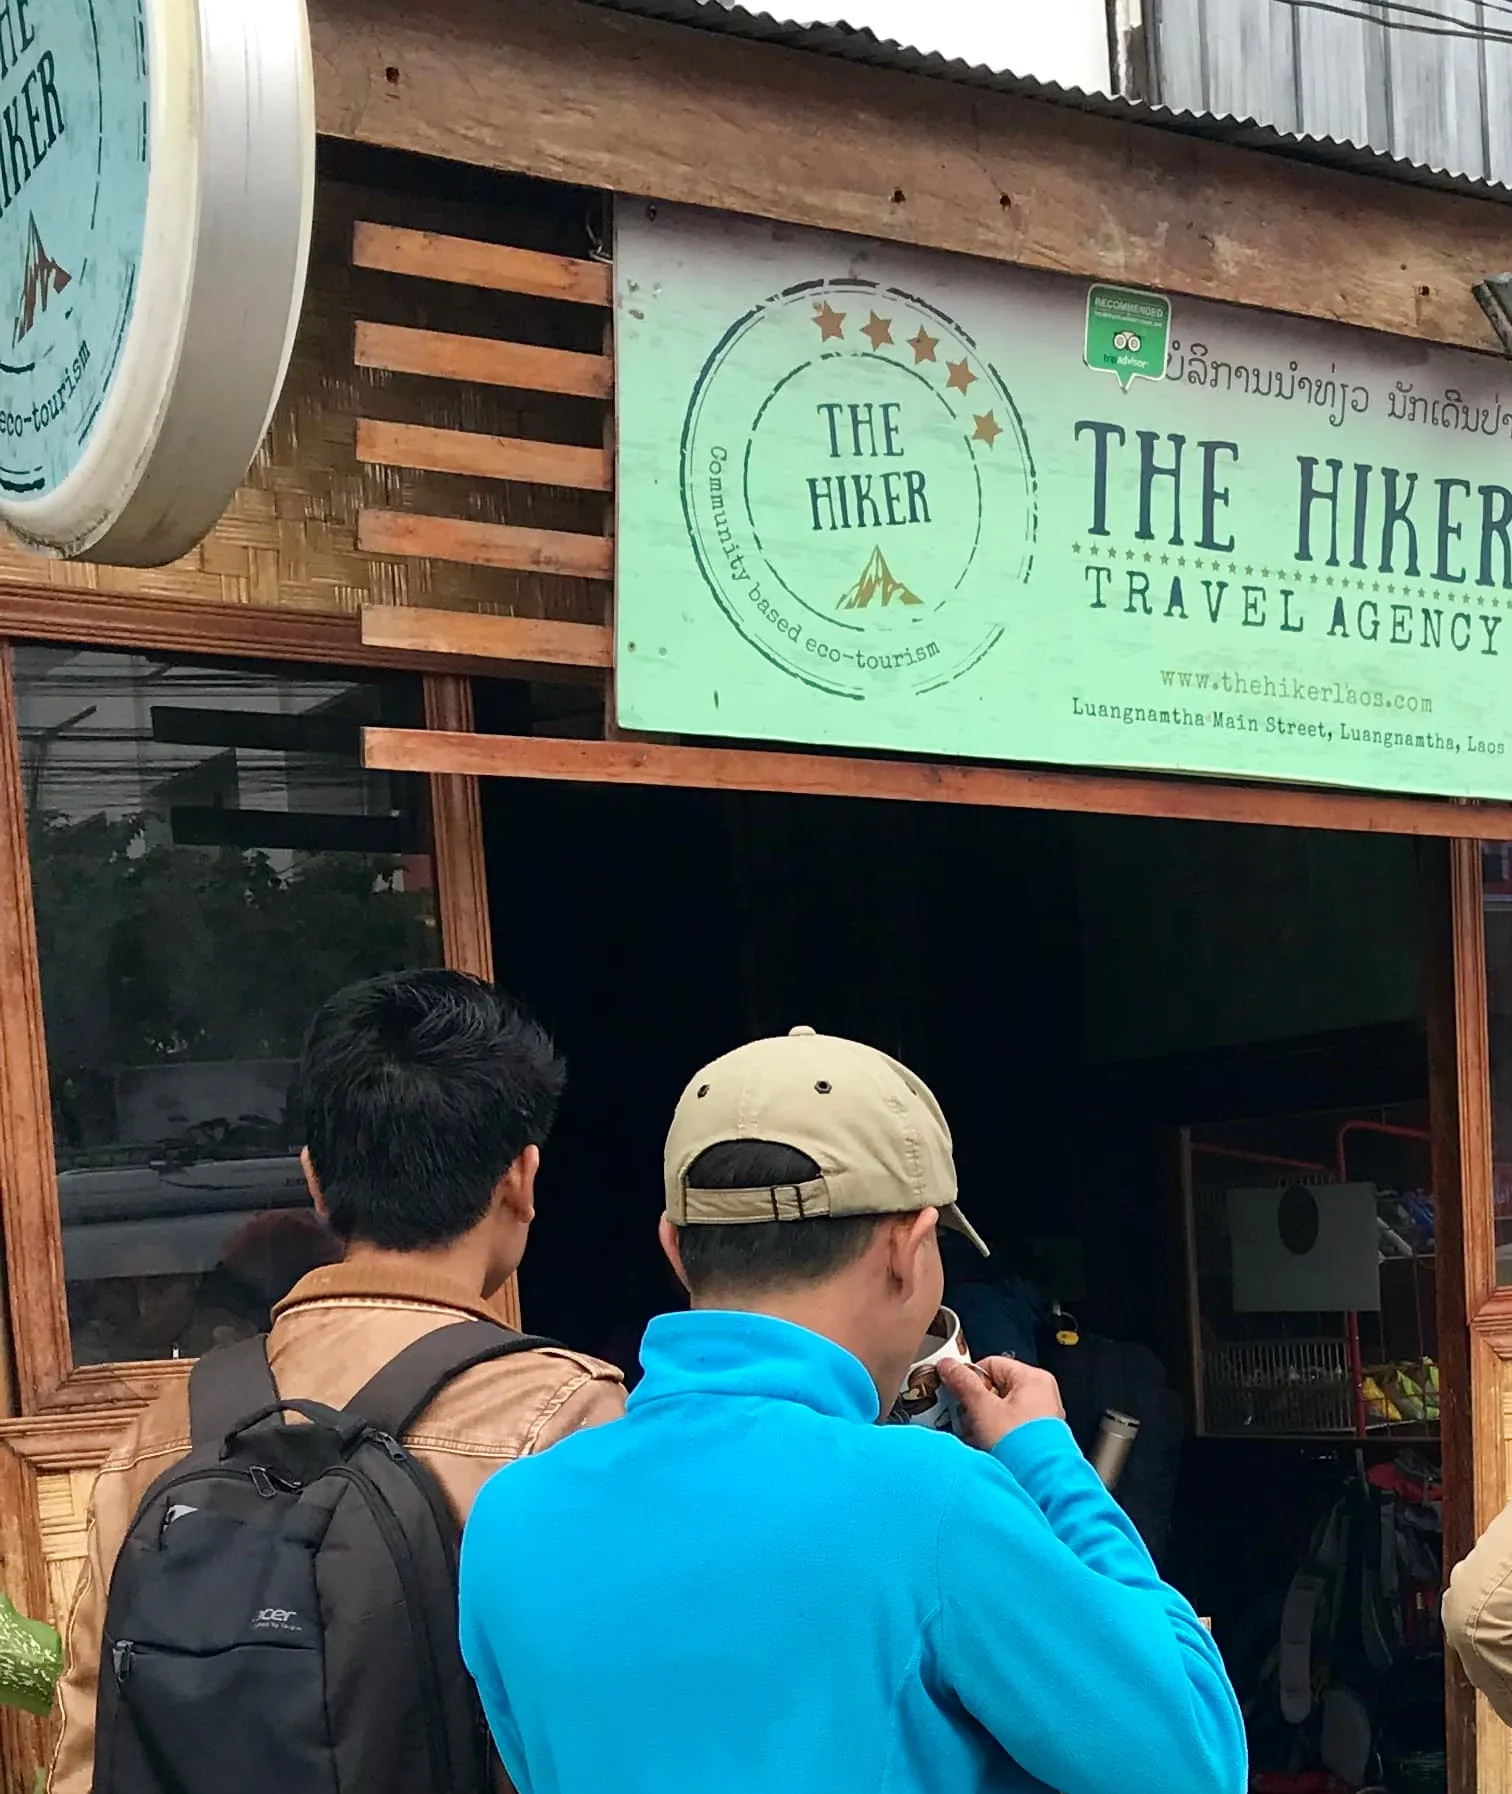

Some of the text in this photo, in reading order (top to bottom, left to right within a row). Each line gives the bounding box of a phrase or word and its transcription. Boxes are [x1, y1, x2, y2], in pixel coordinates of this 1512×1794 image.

[0, 0, 36, 80] HE
[0, 50, 65, 218] IKER
[816, 402, 905, 459] THE
[805, 470, 932, 531] HIKER
[1074, 419, 1240, 553] THE
[709, 446, 941, 670] Community based eco-tourism
[1085, 565, 1502, 656] TRAVEL AGENCY
[1072, 697, 1506, 757] Luangnamtha Main Street, Luangnamtha, Laos
[1160, 667, 1434, 715] www.thehikerlaos.com
